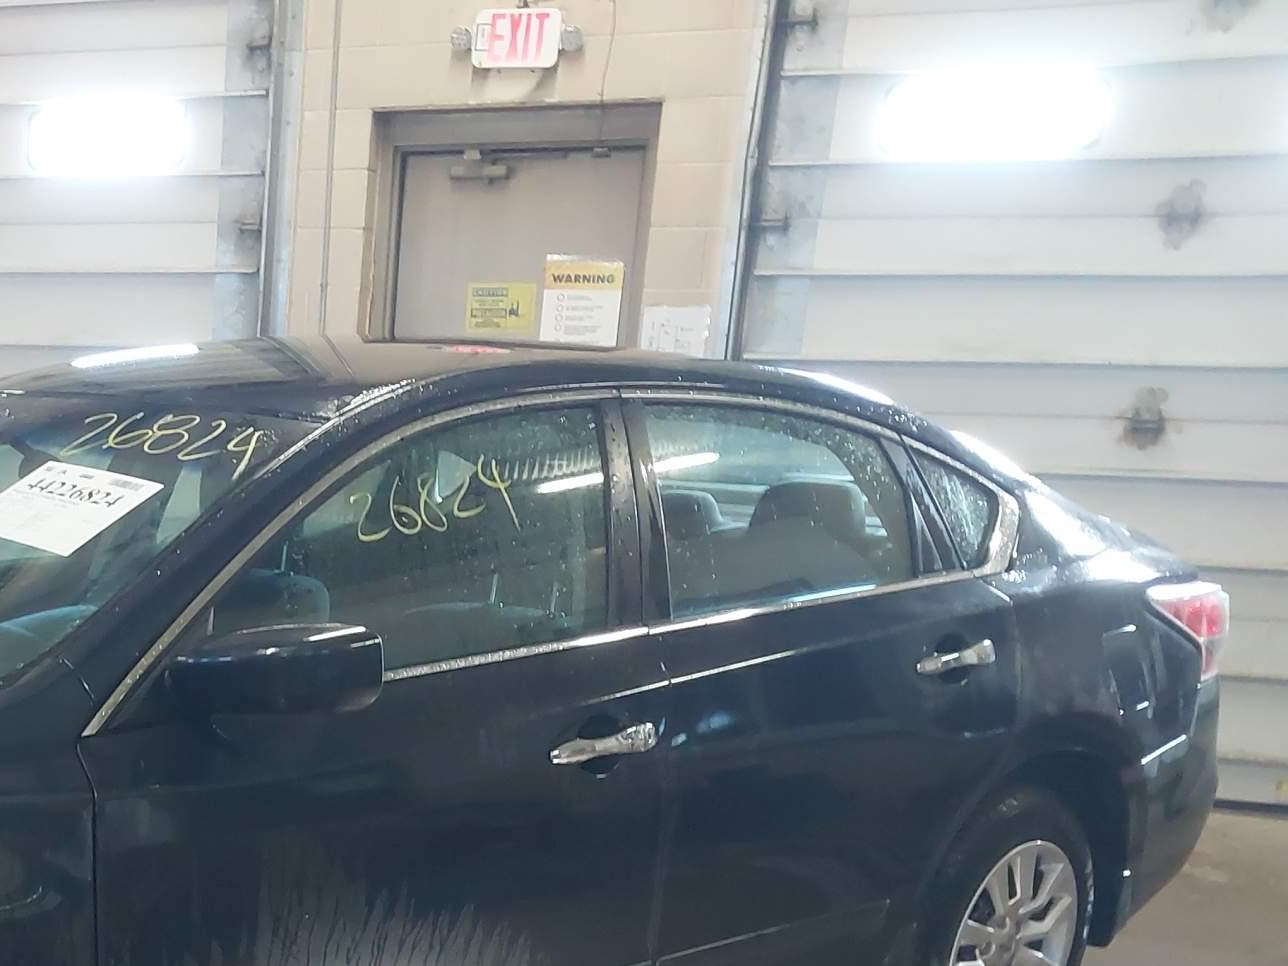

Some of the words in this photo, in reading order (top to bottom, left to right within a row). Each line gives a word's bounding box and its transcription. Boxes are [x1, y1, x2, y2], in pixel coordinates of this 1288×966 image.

[488, 13, 550, 61] EXIT
[552, 272, 616, 284] WARNING
[27, 478, 125, 508] 44226824
[349, 453, 521, 542] 26824
